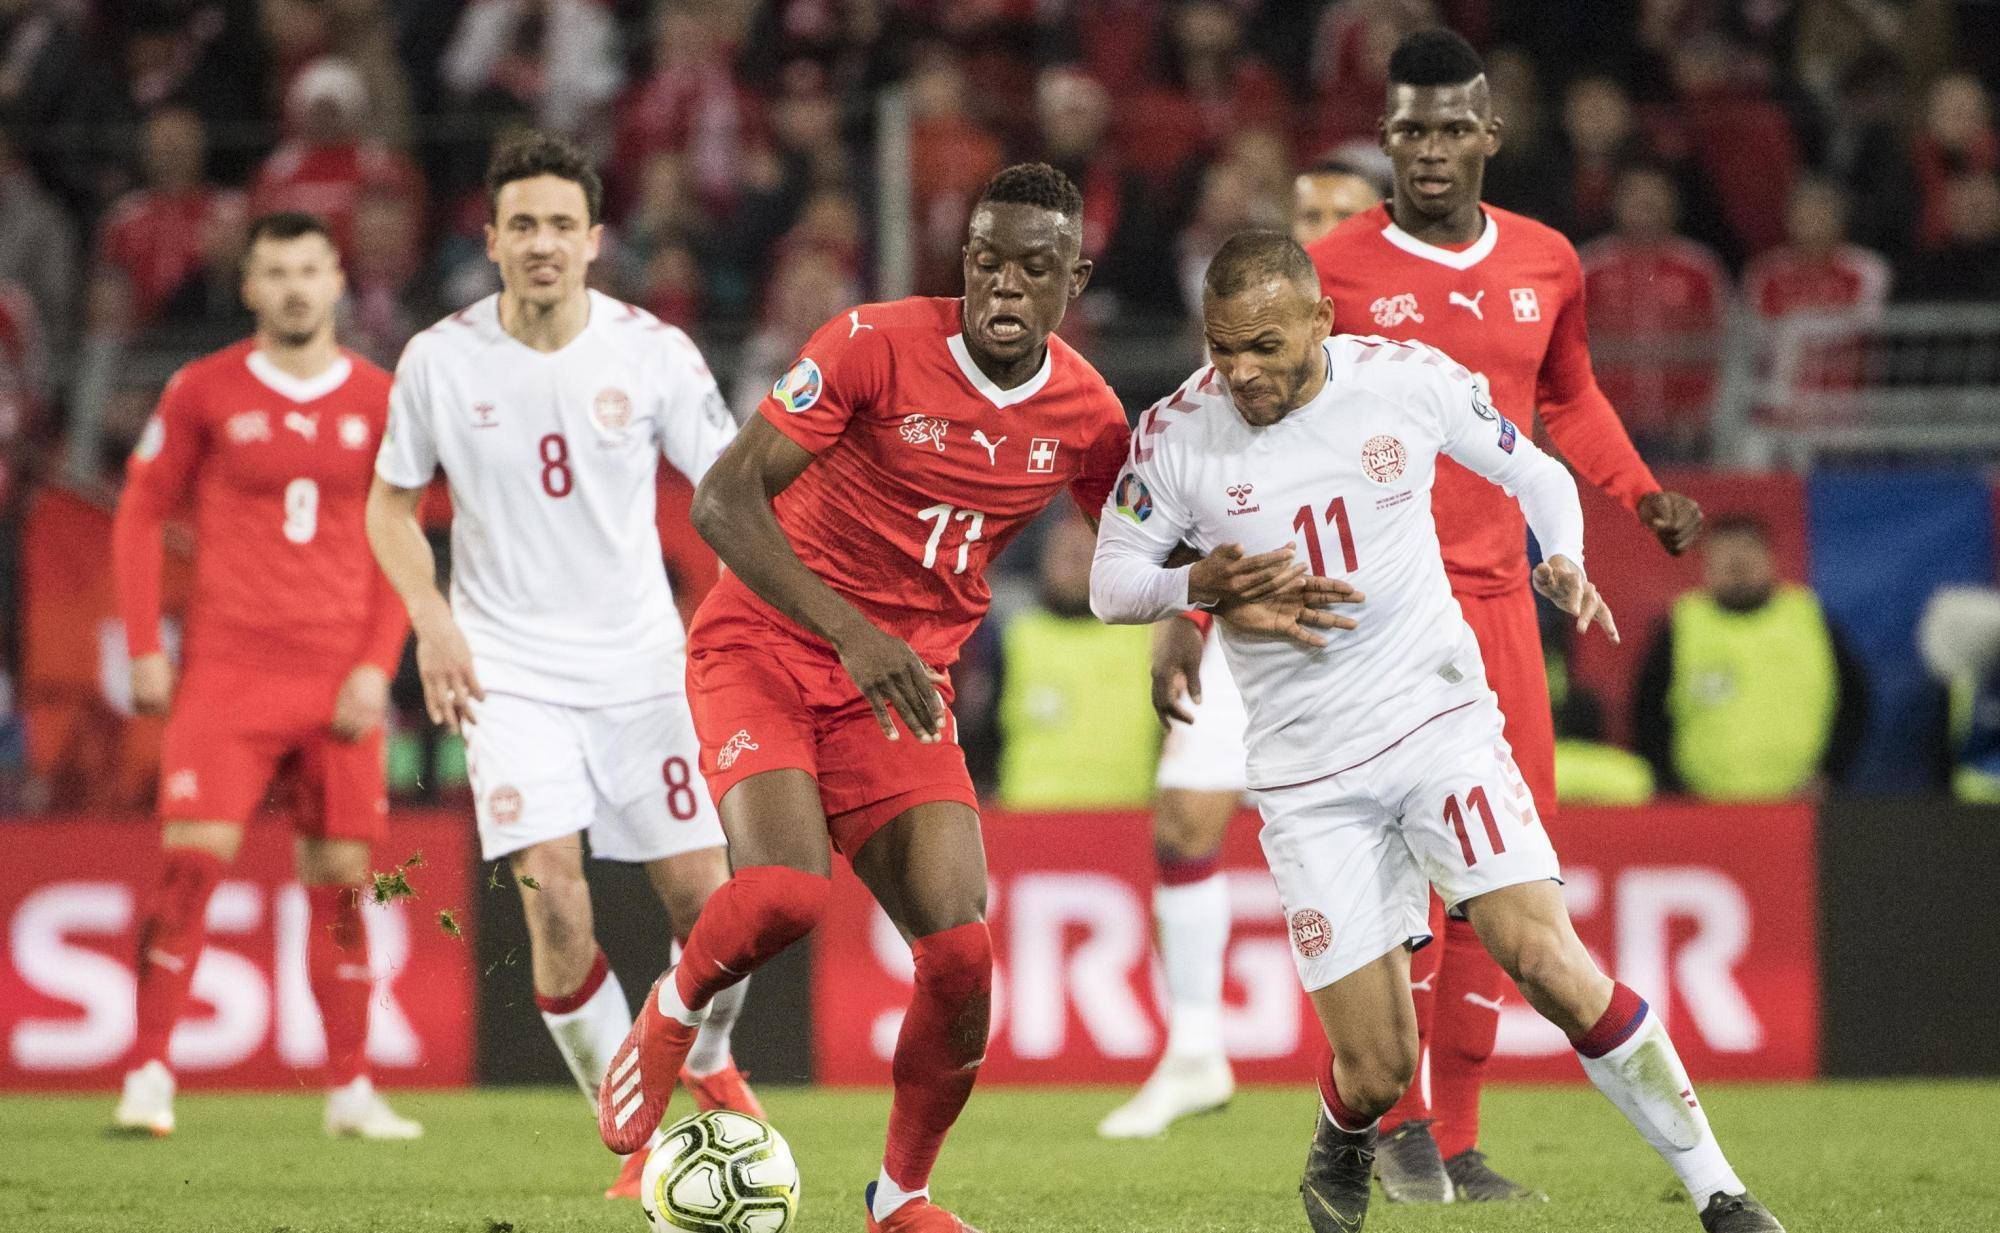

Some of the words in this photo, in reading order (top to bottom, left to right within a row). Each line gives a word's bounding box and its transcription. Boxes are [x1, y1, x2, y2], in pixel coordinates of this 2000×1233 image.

[540, 433, 573, 498] 8
[283, 478, 319, 543] 9
[1227, 504, 1260, 517] hummel
[1293, 496, 1359, 577] 11
[662, 756, 697, 821] 8
[1443, 785, 1506, 868] 11
